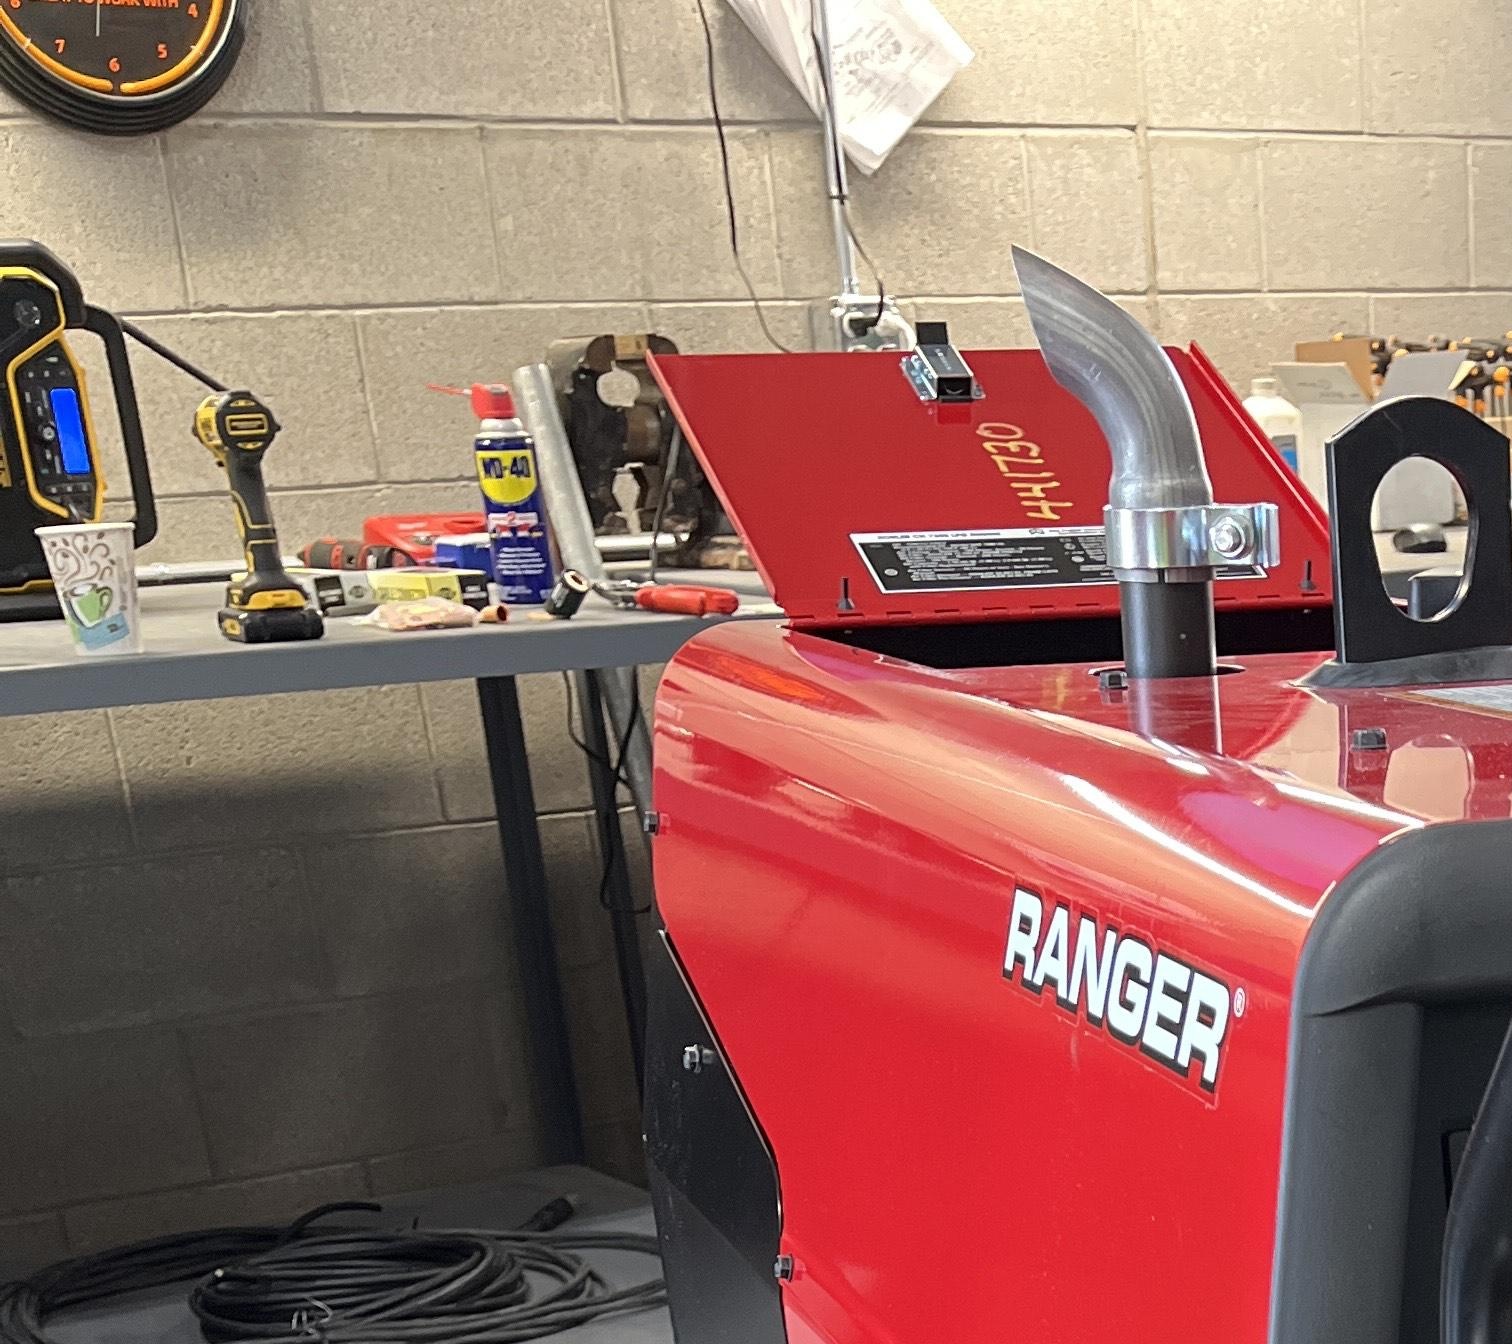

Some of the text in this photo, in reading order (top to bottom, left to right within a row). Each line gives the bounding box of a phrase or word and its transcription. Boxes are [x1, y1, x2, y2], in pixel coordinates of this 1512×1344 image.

[187, 3, 199, 18] 4
[54, 39, 66, 54] 7
[157, 43, 168, 59] 5
[108, 57, 121, 73] 6
